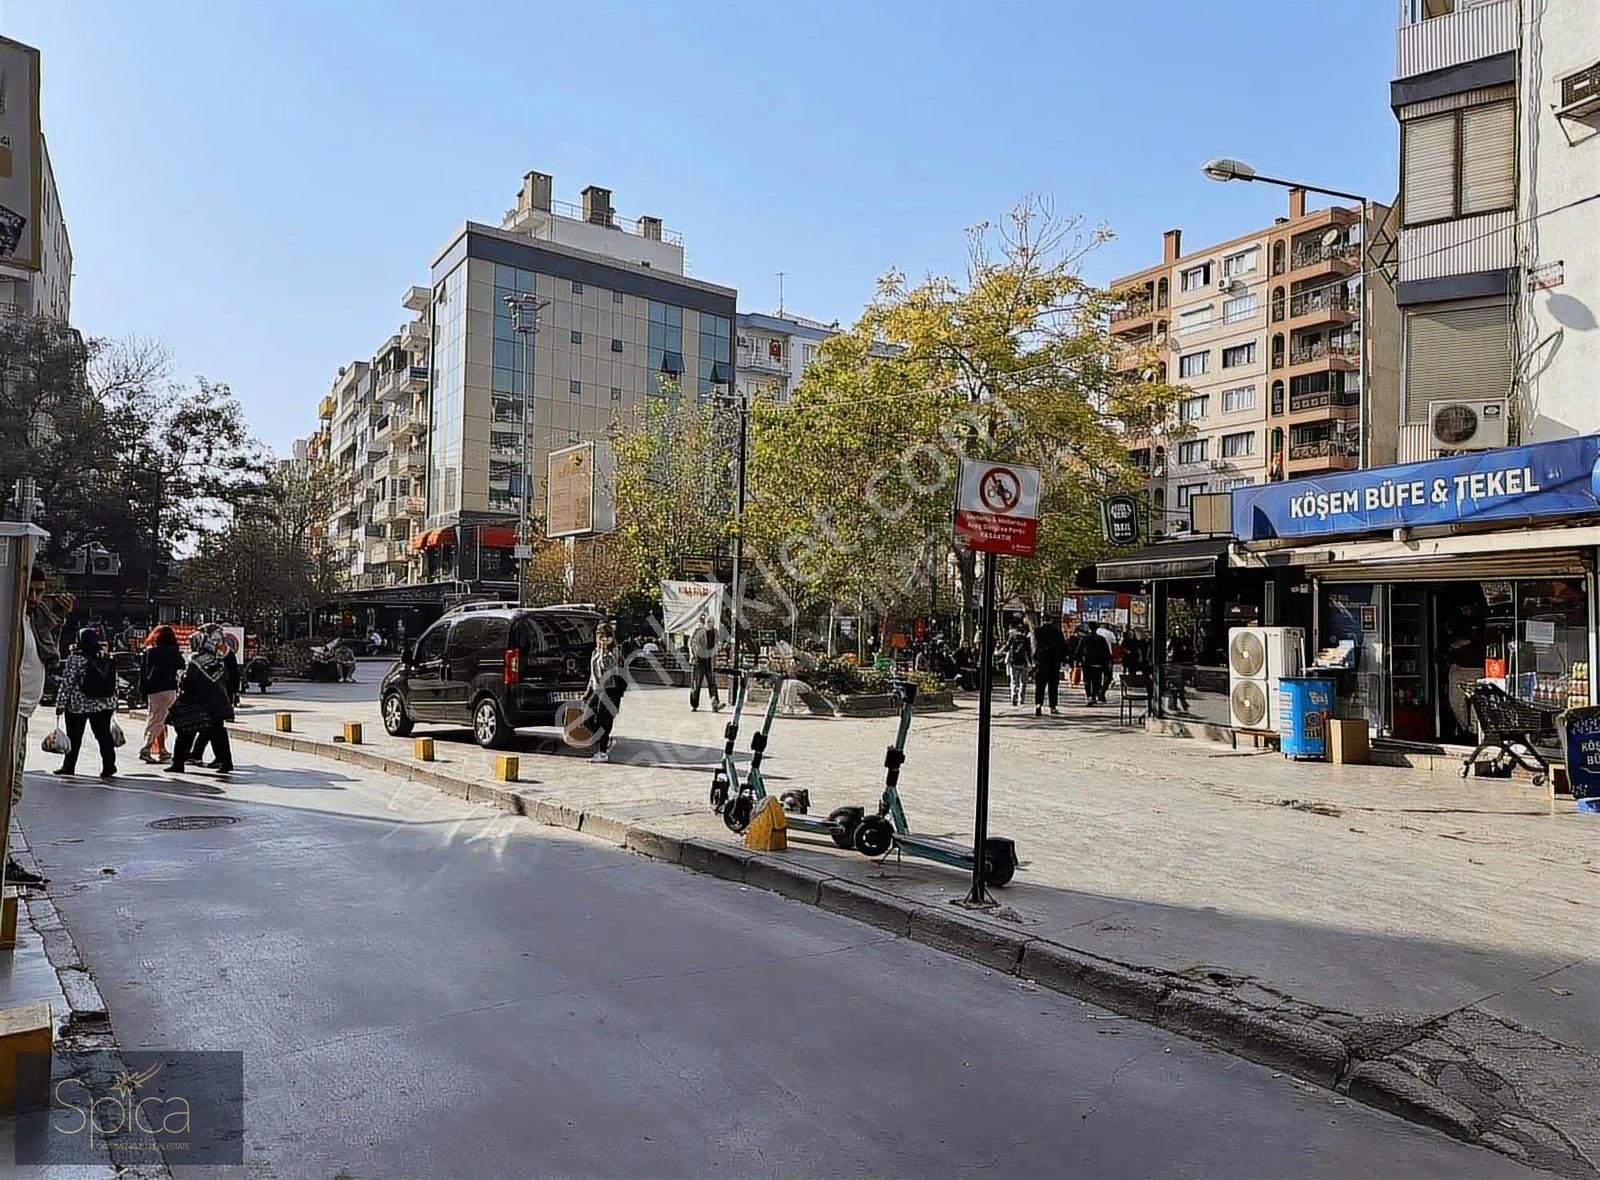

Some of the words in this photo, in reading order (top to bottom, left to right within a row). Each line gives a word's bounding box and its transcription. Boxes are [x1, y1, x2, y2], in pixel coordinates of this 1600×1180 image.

[1290, 490, 1359, 521] KÖŞEM
[1365, 479, 1425, 510] BÜFE
[1432, 478, 1449, 504] &
[1453, 466, 1541, 502] TEKEL
